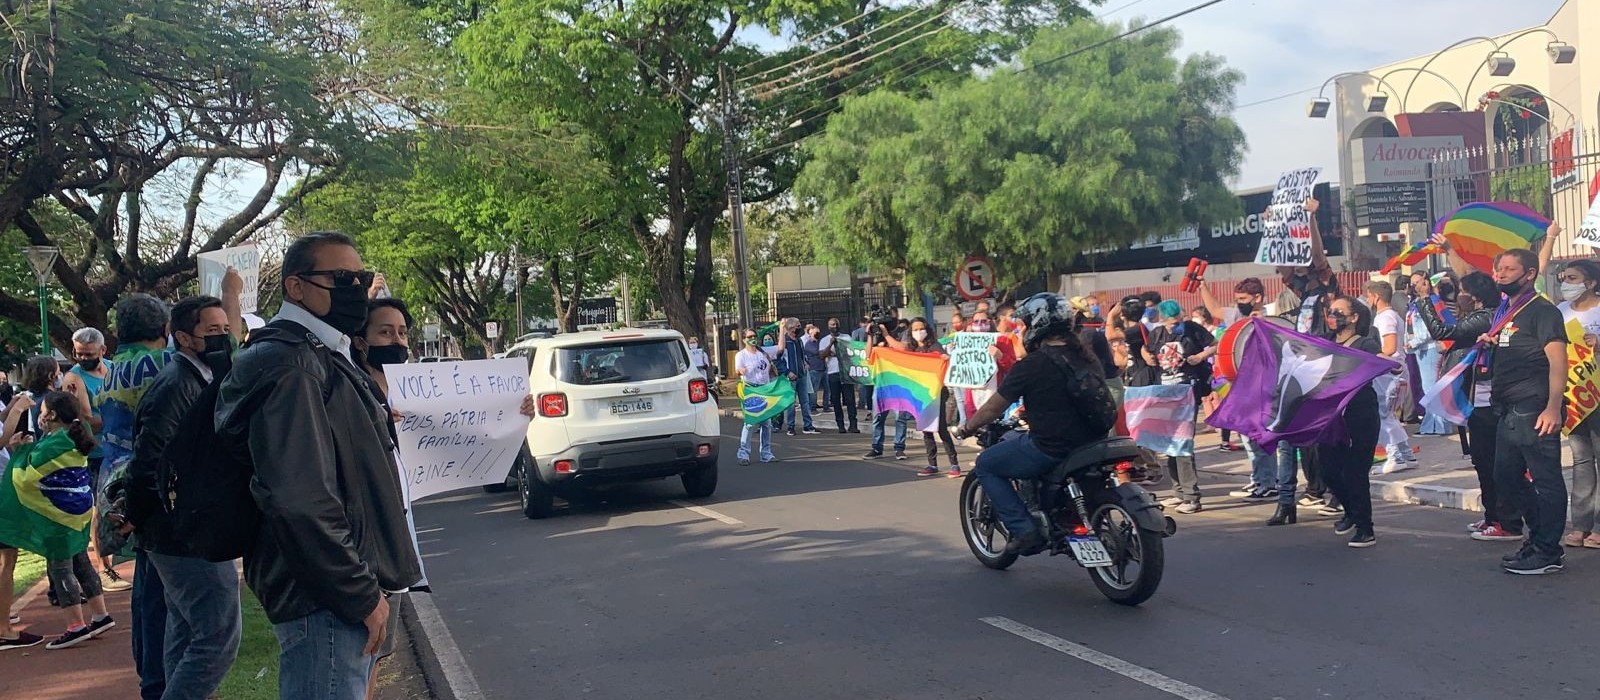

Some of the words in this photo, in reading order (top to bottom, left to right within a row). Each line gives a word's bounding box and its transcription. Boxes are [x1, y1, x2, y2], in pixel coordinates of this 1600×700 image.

[1373, 142, 1460, 162] Advocacia
[469, 375, 482, 395] A
[487, 375, 526, 394] FAVOR
